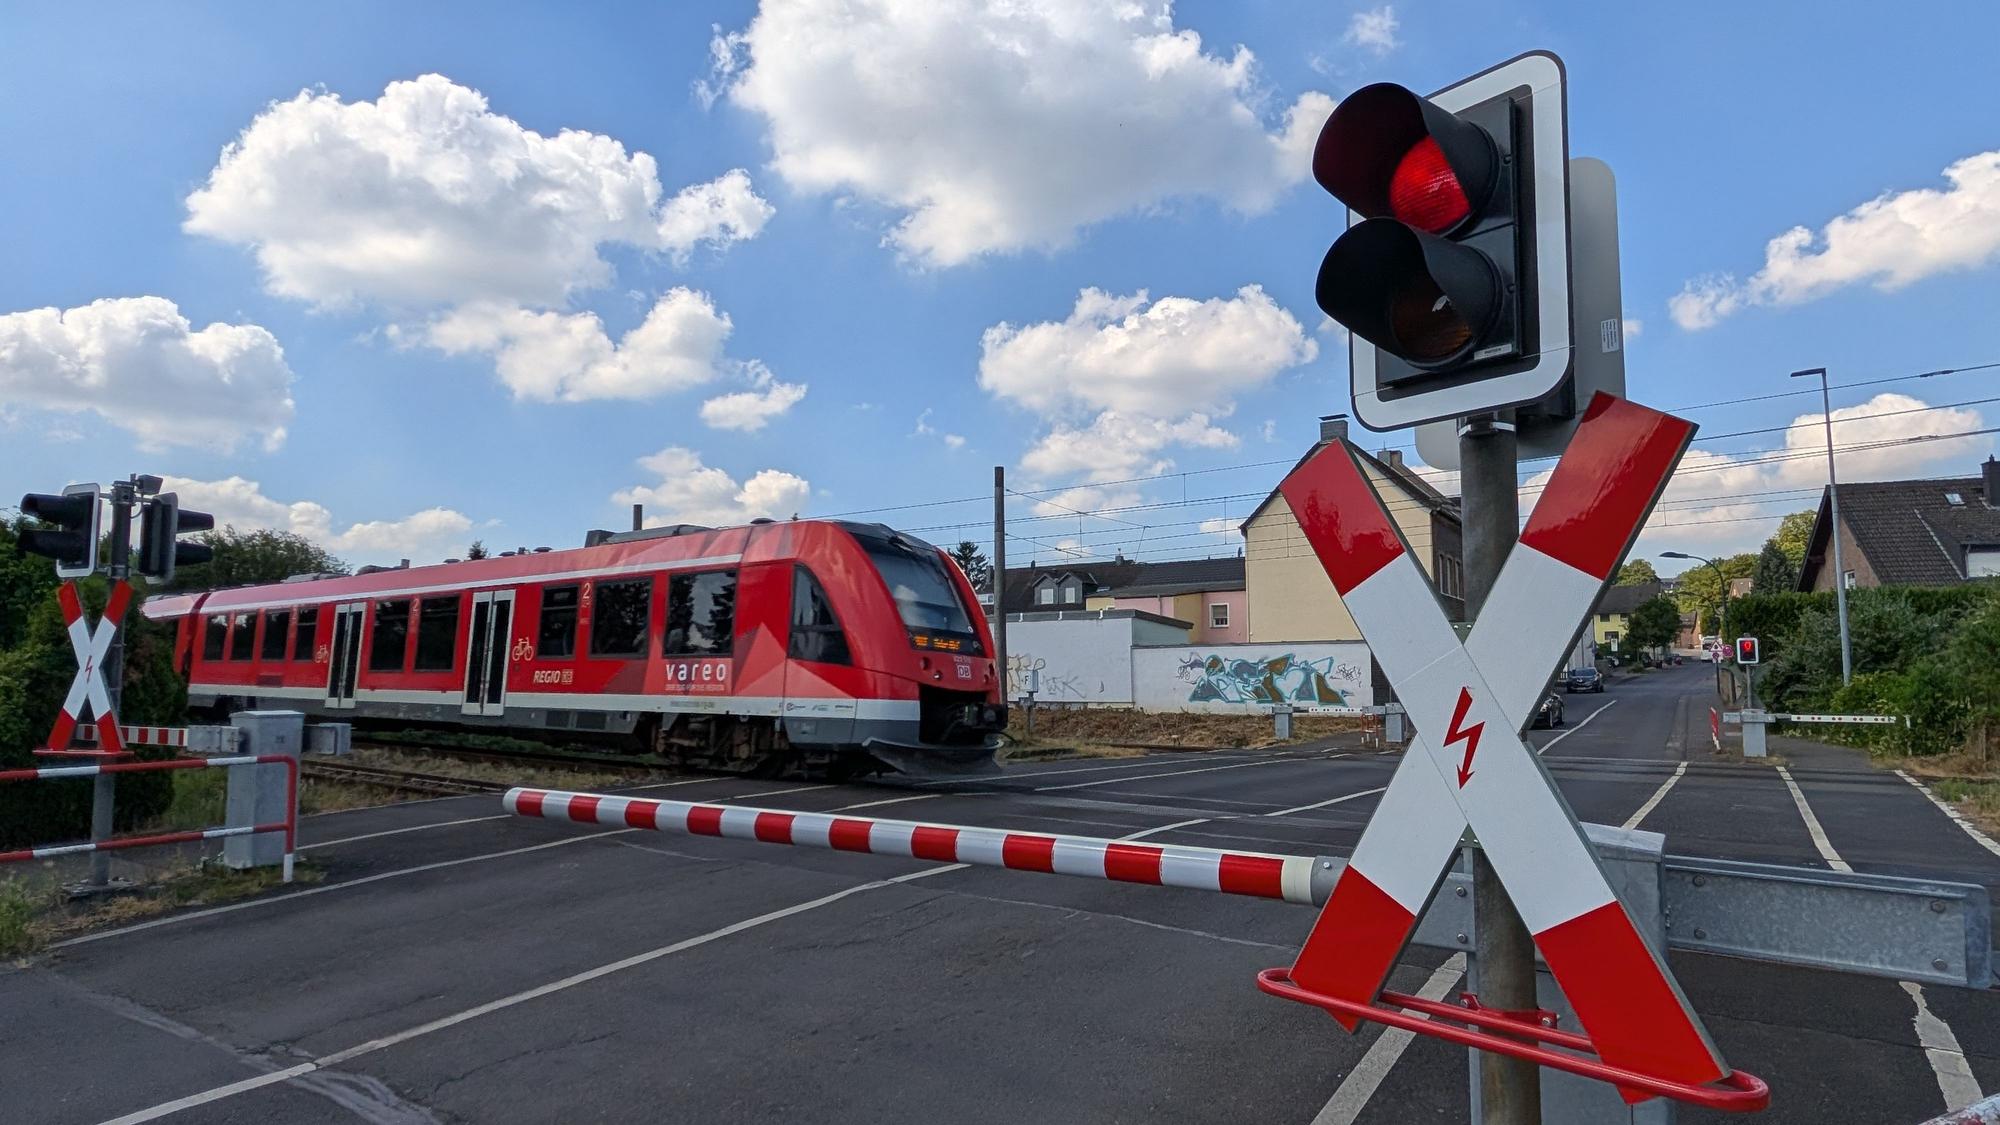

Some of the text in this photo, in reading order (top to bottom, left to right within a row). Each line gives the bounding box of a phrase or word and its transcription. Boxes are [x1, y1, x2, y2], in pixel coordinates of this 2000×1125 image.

[583, 582, 591, 599] 2
[533, 670, 561, 683] REGIO
[665, 663, 726, 681] vareo
[958, 665, 970, 677] DB
